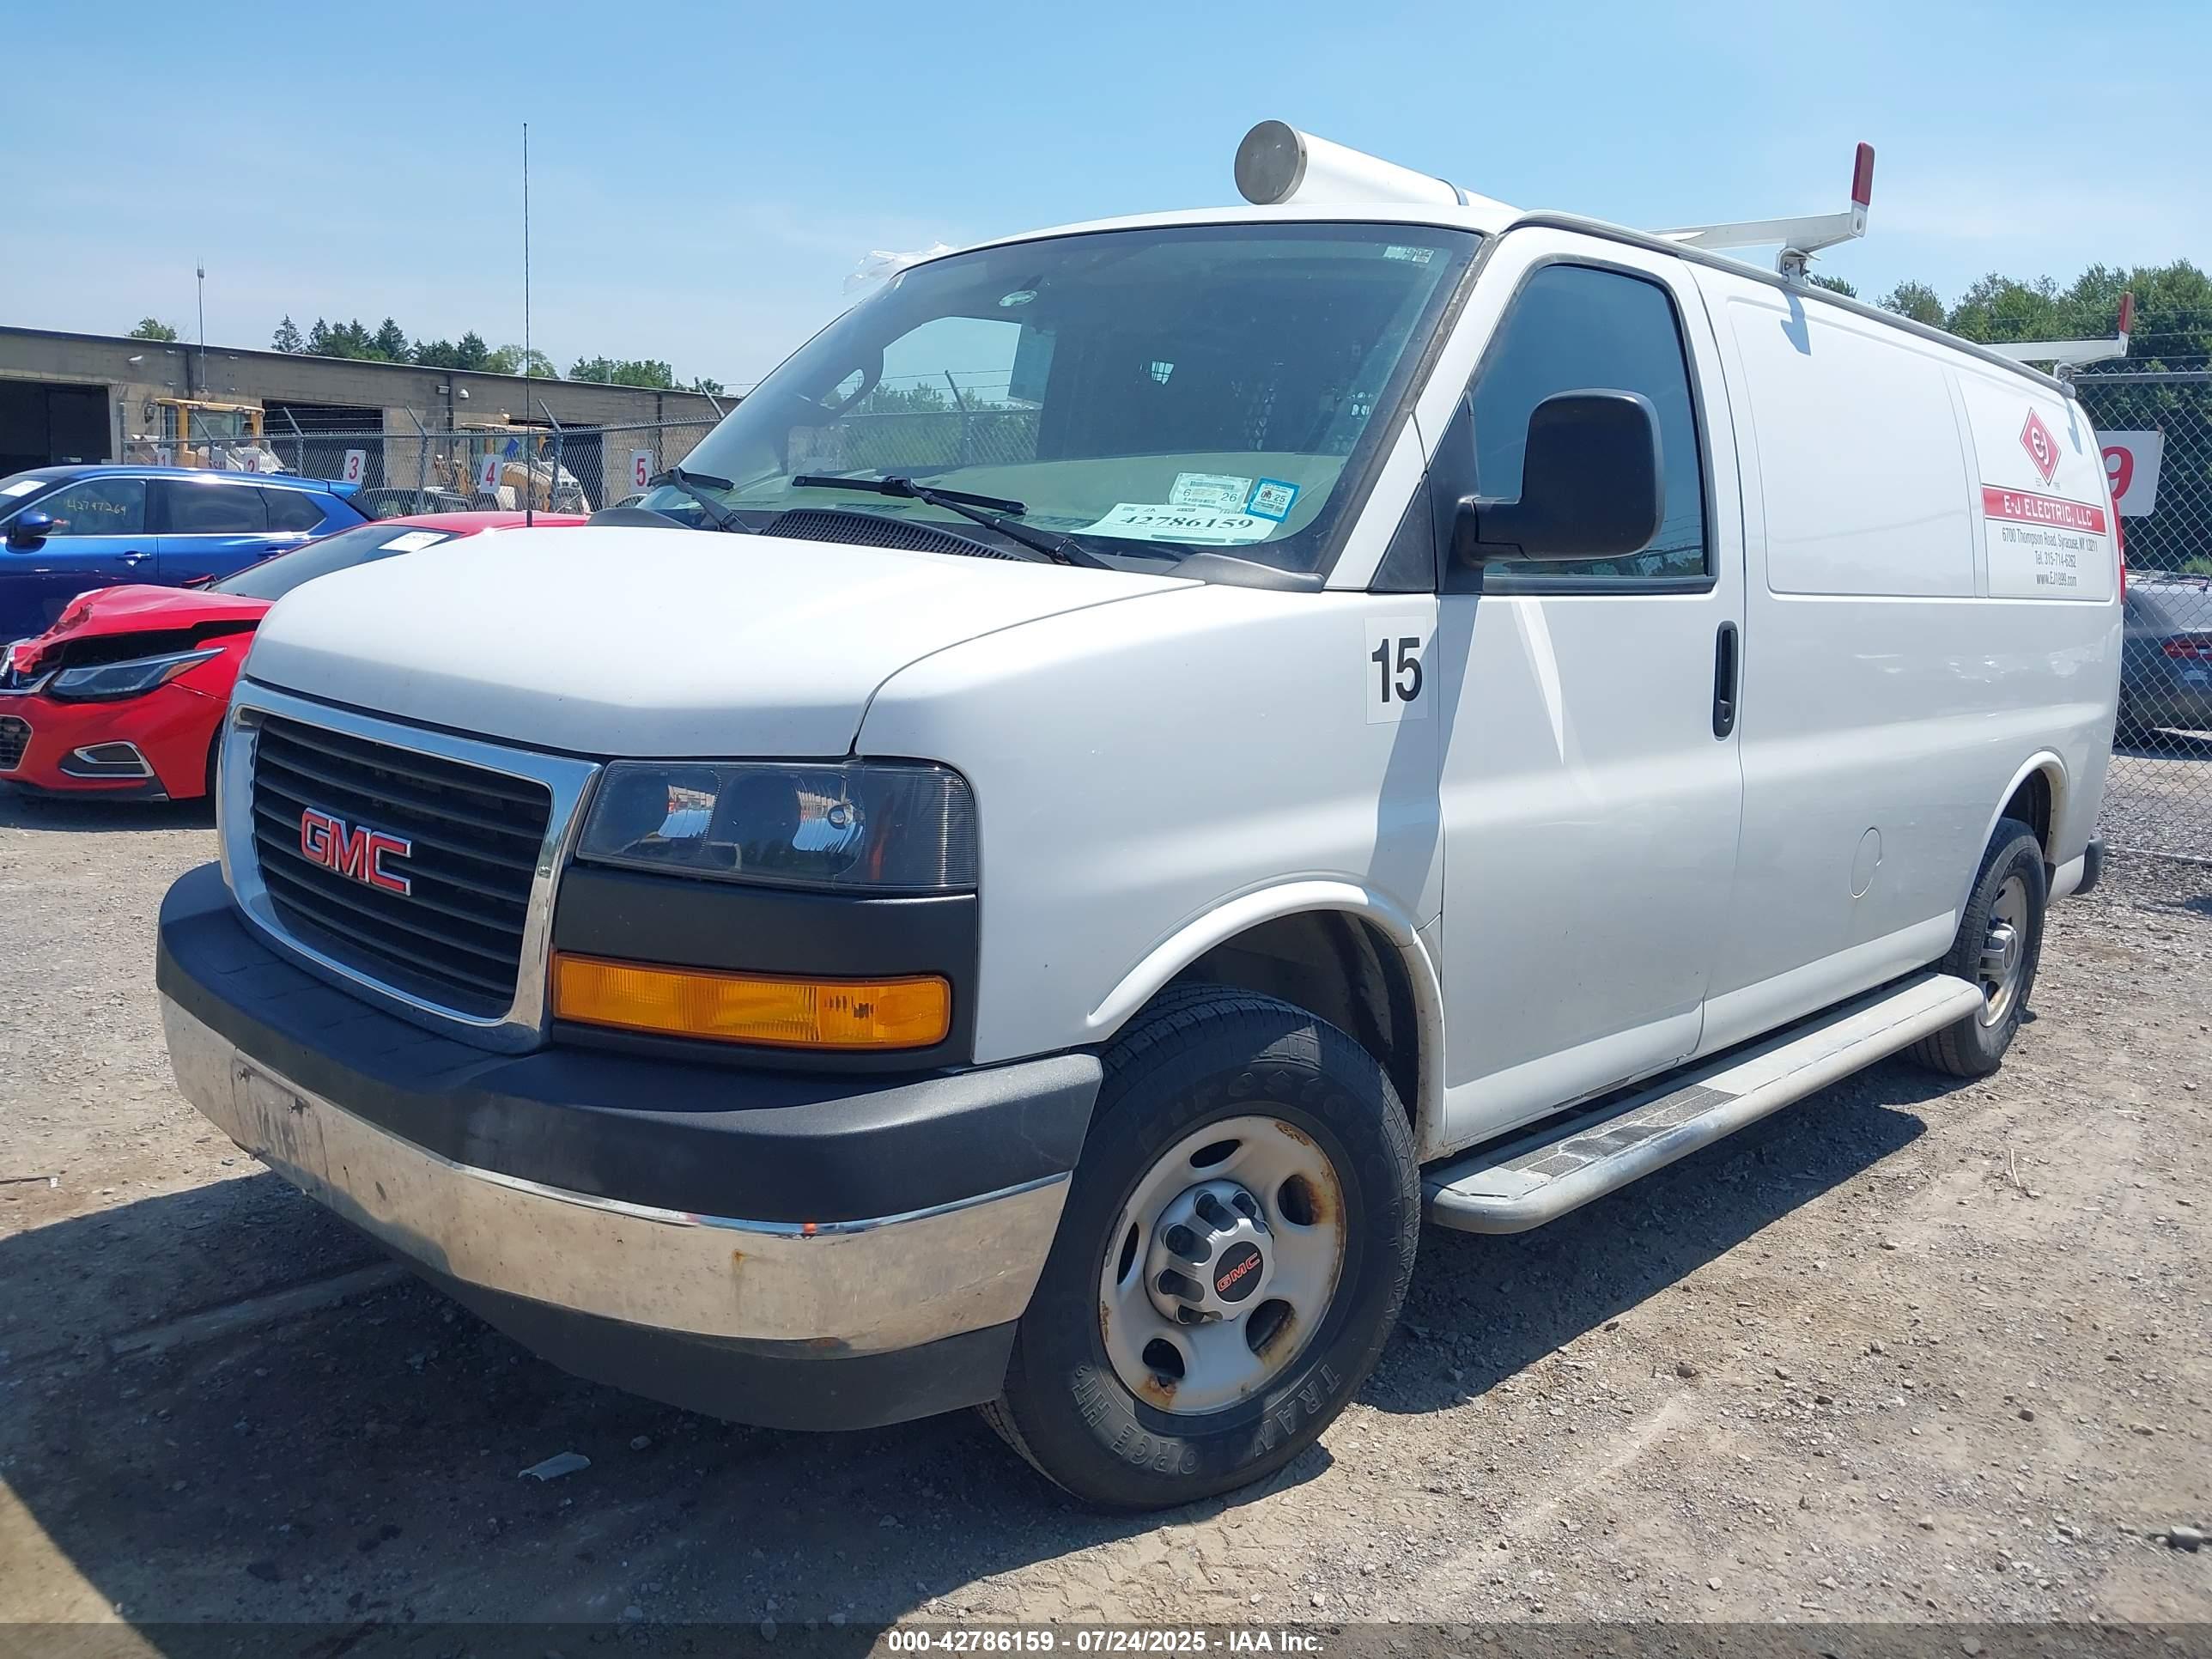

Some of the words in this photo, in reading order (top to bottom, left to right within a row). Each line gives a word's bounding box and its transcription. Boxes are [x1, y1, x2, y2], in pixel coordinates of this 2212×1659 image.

[247, 459, 255, 472] 2
[349, 456, 359, 479] 3
[486, 462, 495, 486] 4
[636, 458, 647, 486] 5
[2101, 446, 2134, 501] 9
[1182, 489, 1192, 497] 6
[1220, 492, 1237, 502] 26
[1120, 515, 1254, 530] 42786159
[2024, 498, 2075, 526] ELECTRIC,
[2076, 507, 2093, 526] LLC
[2002, 528, 2016, 543] 6700
[2017, 529, 2044, 547] Thompson
[2044, 532, 2057, 547] Road,
[2057, 534, 2079, 551] Syracuse,
[2079, 537, 2086, 550] NY
[1372, 637, 1423, 703] 15
[301, 807, 411, 896] GMC
[1217, 1252, 1261, 1291] GMC
